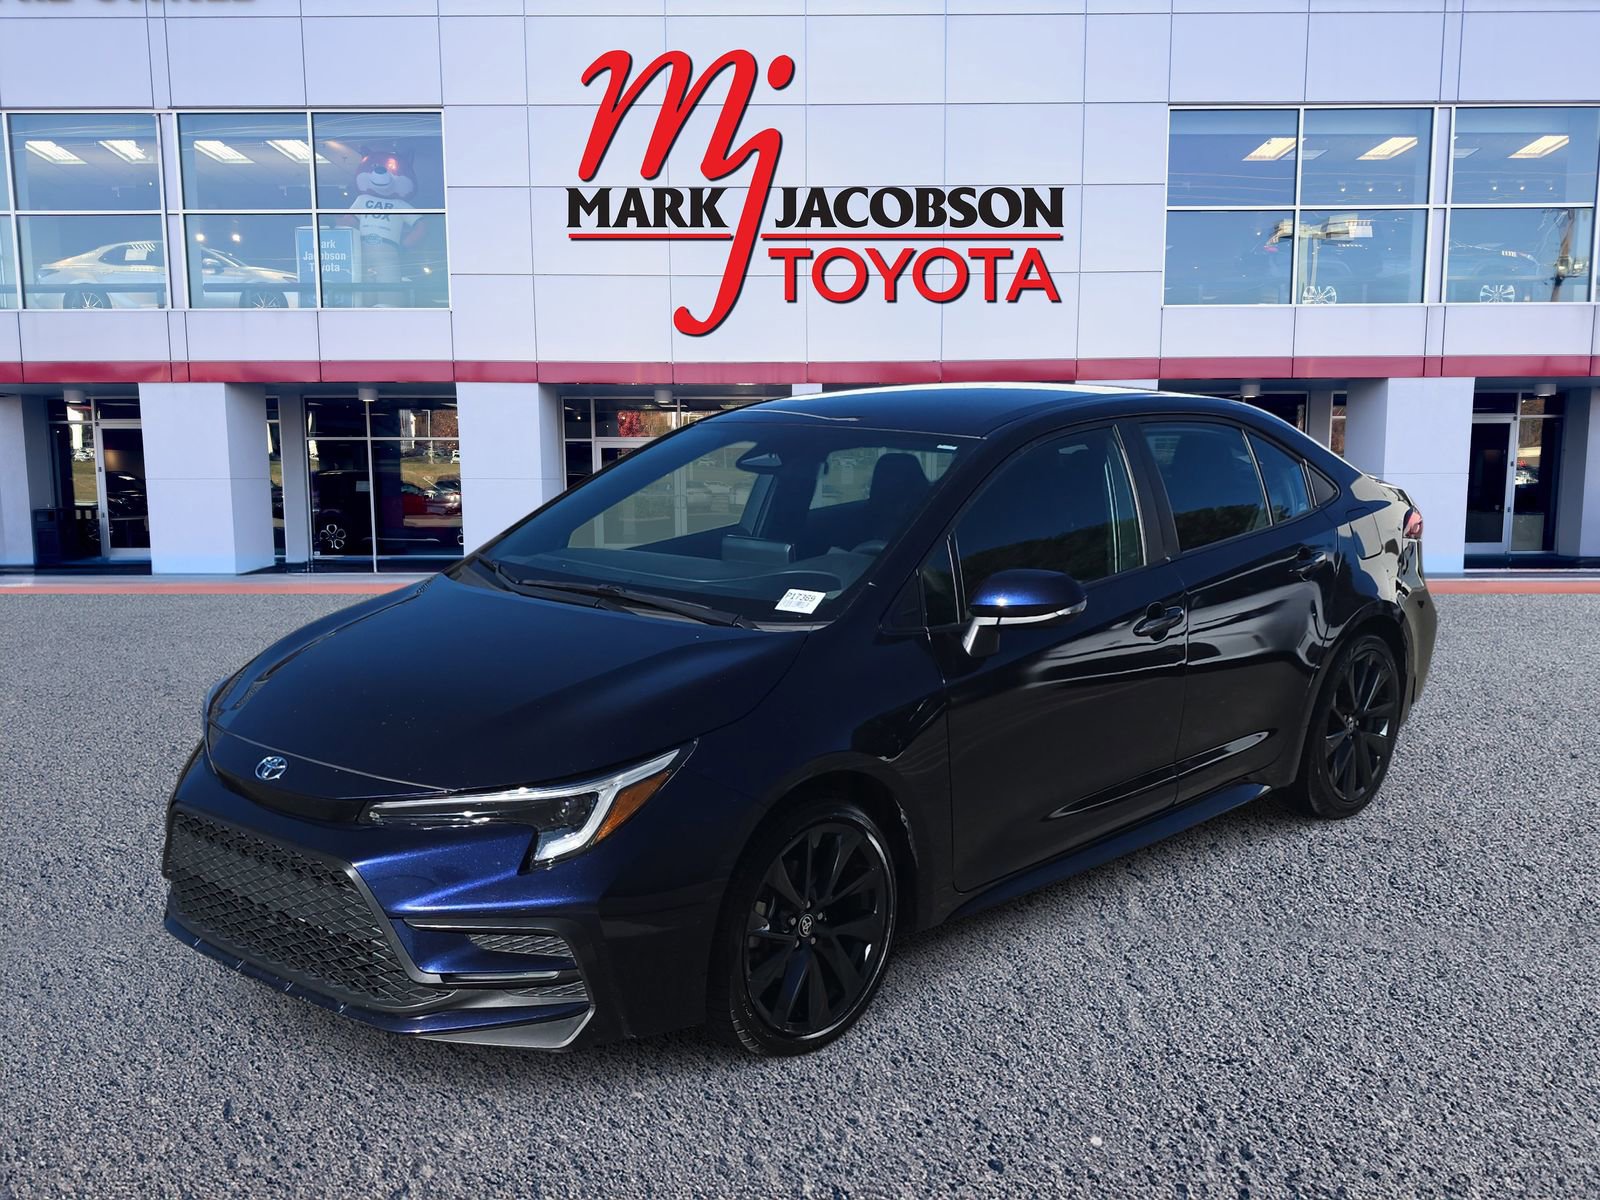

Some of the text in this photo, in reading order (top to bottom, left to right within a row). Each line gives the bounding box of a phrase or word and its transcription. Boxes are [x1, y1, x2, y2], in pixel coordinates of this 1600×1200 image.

[566, 187, 1064, 228] MARK JACOBSON
[768, 247, 1062, 303] TOYOTA
